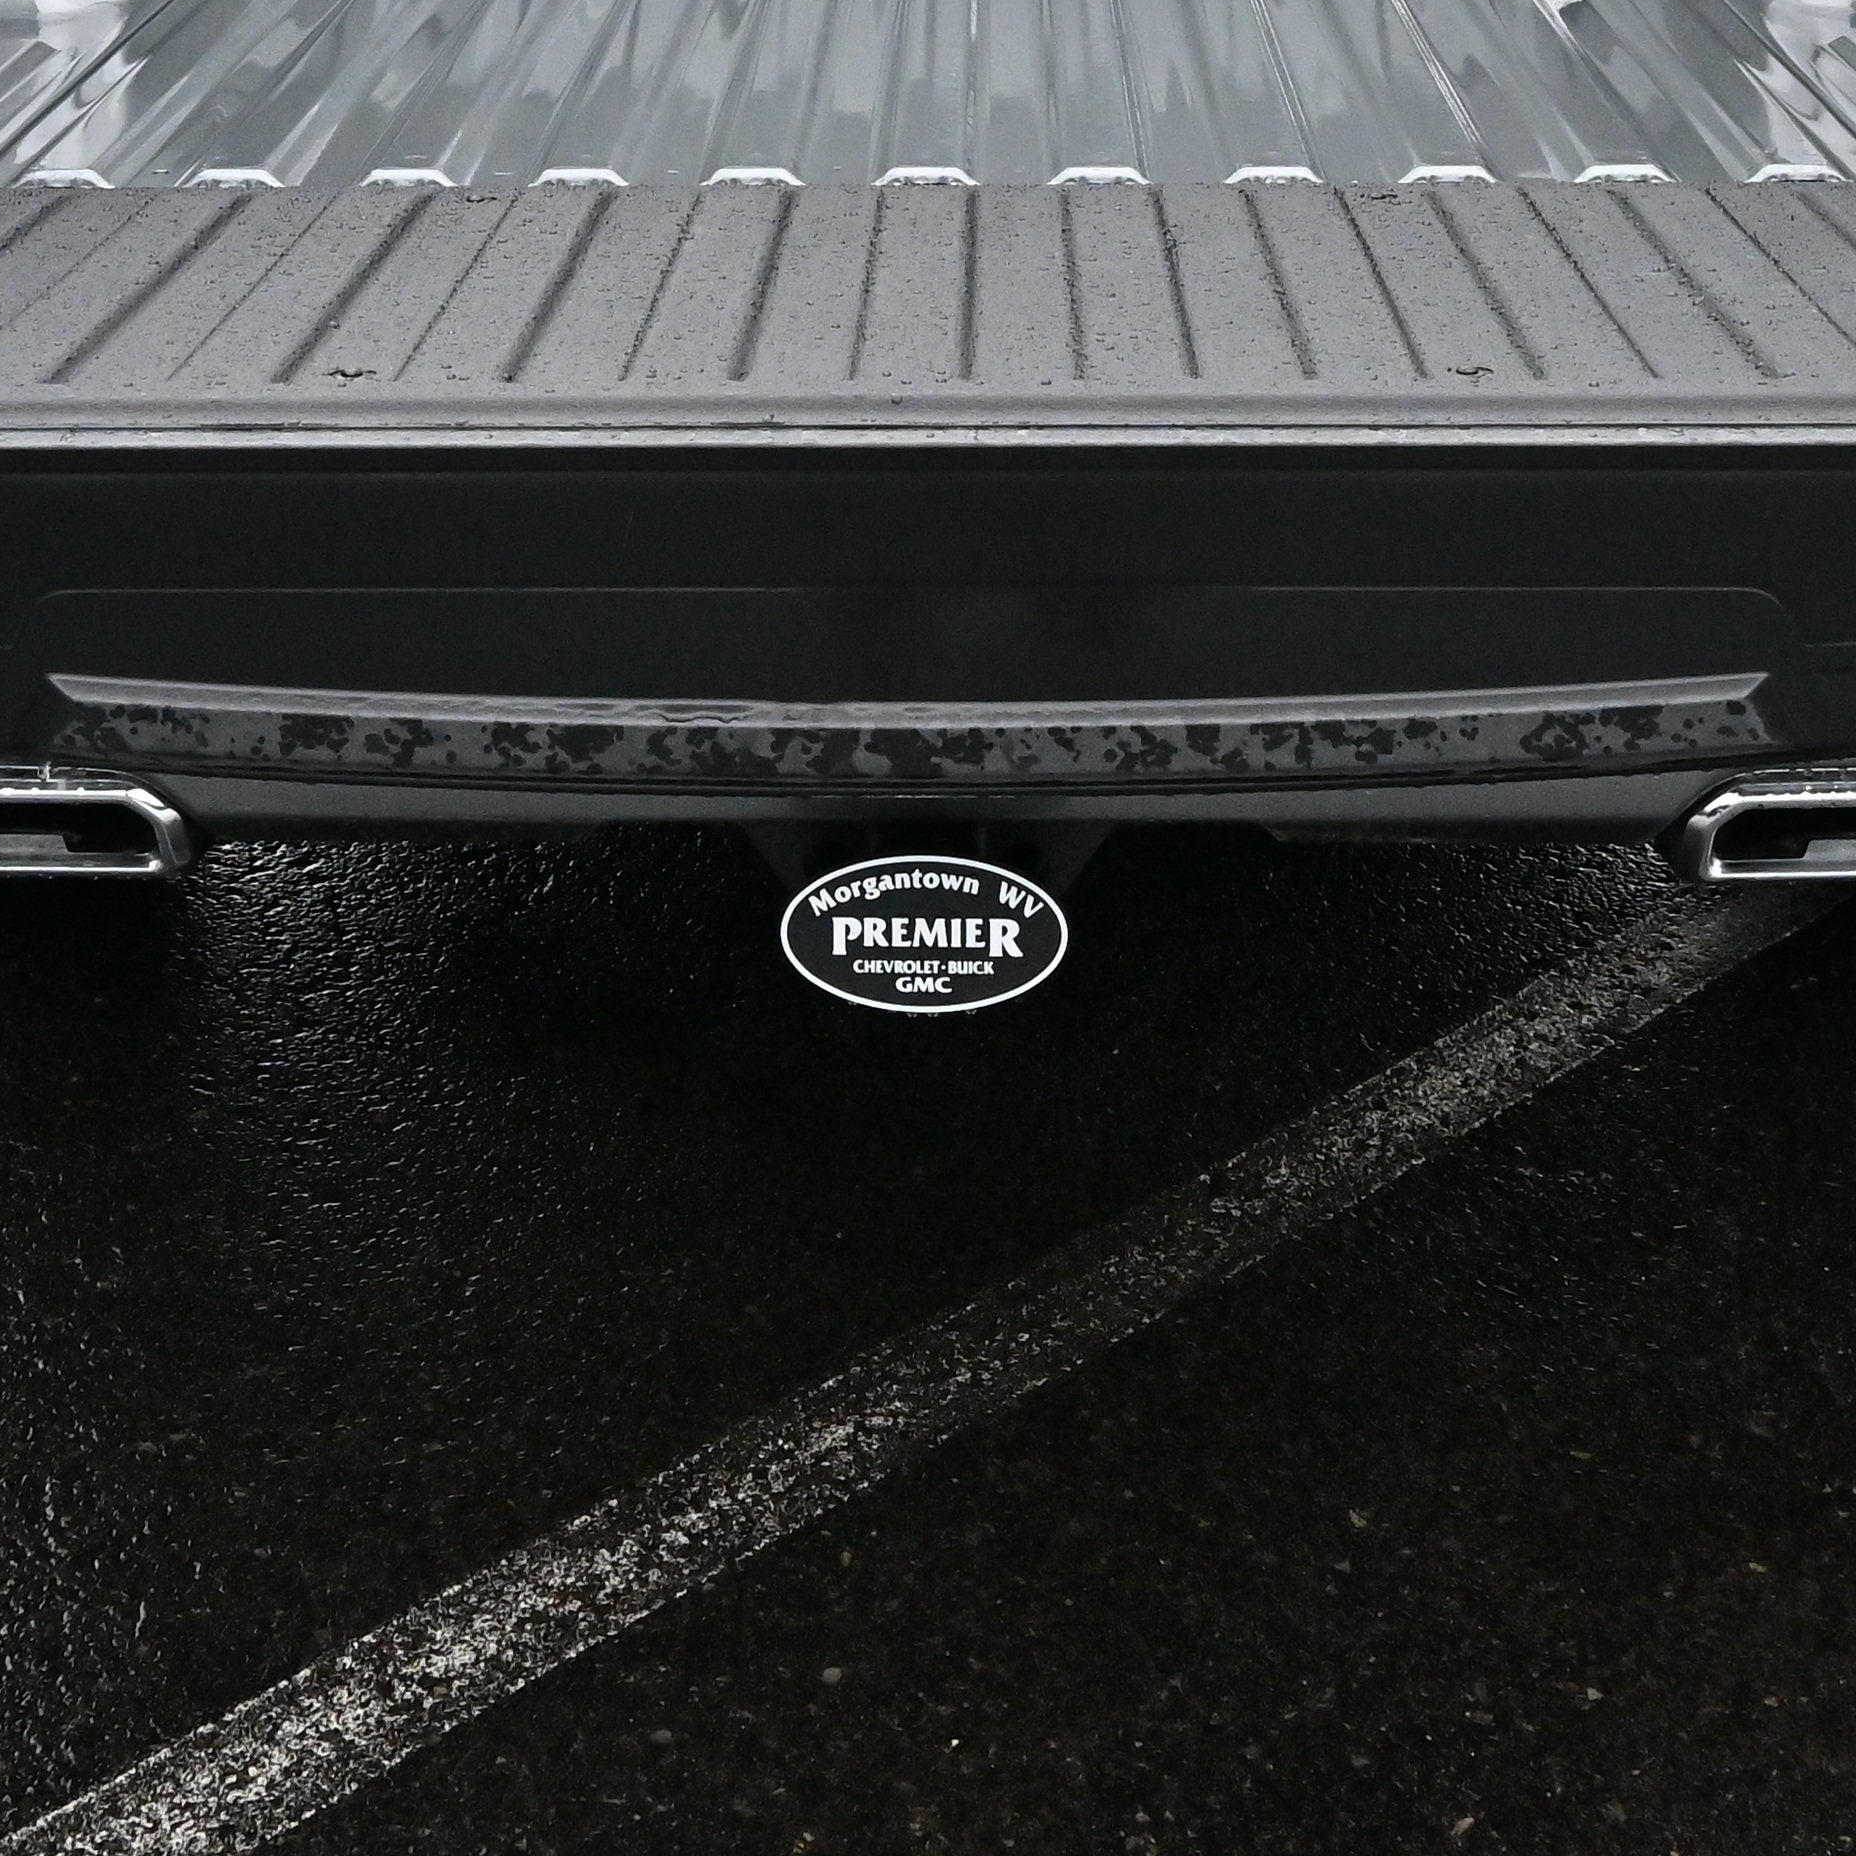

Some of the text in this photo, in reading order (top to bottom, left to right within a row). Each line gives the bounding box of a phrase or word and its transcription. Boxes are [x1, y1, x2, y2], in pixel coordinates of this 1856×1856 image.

[807, 867, 1044, 919] Morgantown WV
[831, 916, 1024, 958] PREMIER
[895, 976, 953, 993] GMC
